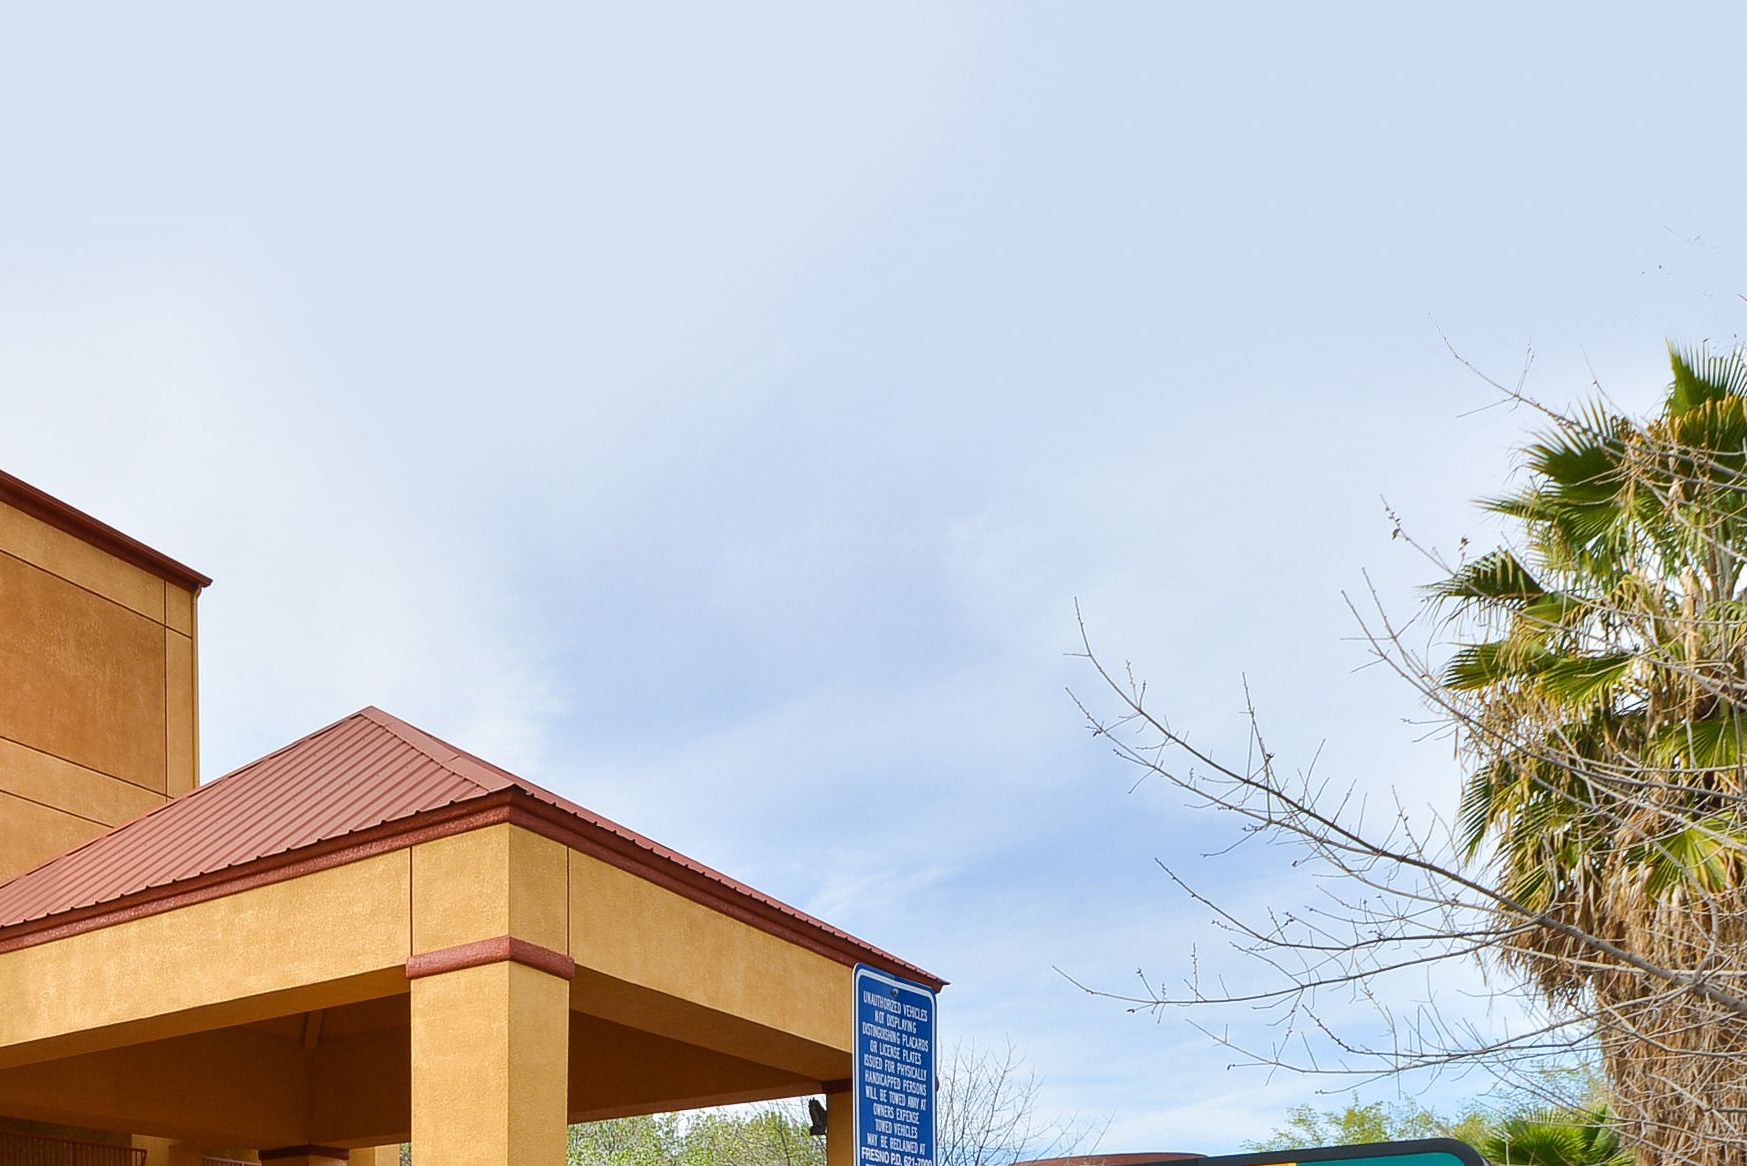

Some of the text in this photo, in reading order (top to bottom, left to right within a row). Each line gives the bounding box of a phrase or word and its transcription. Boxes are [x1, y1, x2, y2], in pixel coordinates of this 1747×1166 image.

[863, 991, 927, 1022] UNAUTHORIZED VEHICLES
[875, 1010, 916, 1034] NOT DISPLAYING
[862, 1022, 928, 1052] DISTINGUISHING PLACARDS
[870, 1040, 921, 1065] OR LICENSE PLATES
[864, 1054, 927, 1081] ISSUED FOR PHYSICALLY
[865, 1070, 926, 1096] HANDICAPPED PERSONS
[865, 1086, 926, 1111] WILL BE TOWED AWAY AT
[896, 1108, 919, 1124] EXPENSE
[875, 1119, 917, 1139] TOWED VEHICLES
[862, 1147, 889, 1164] FRESNO
[867, 1133, 925, 1155] MAY BE RECLAIMED AT
